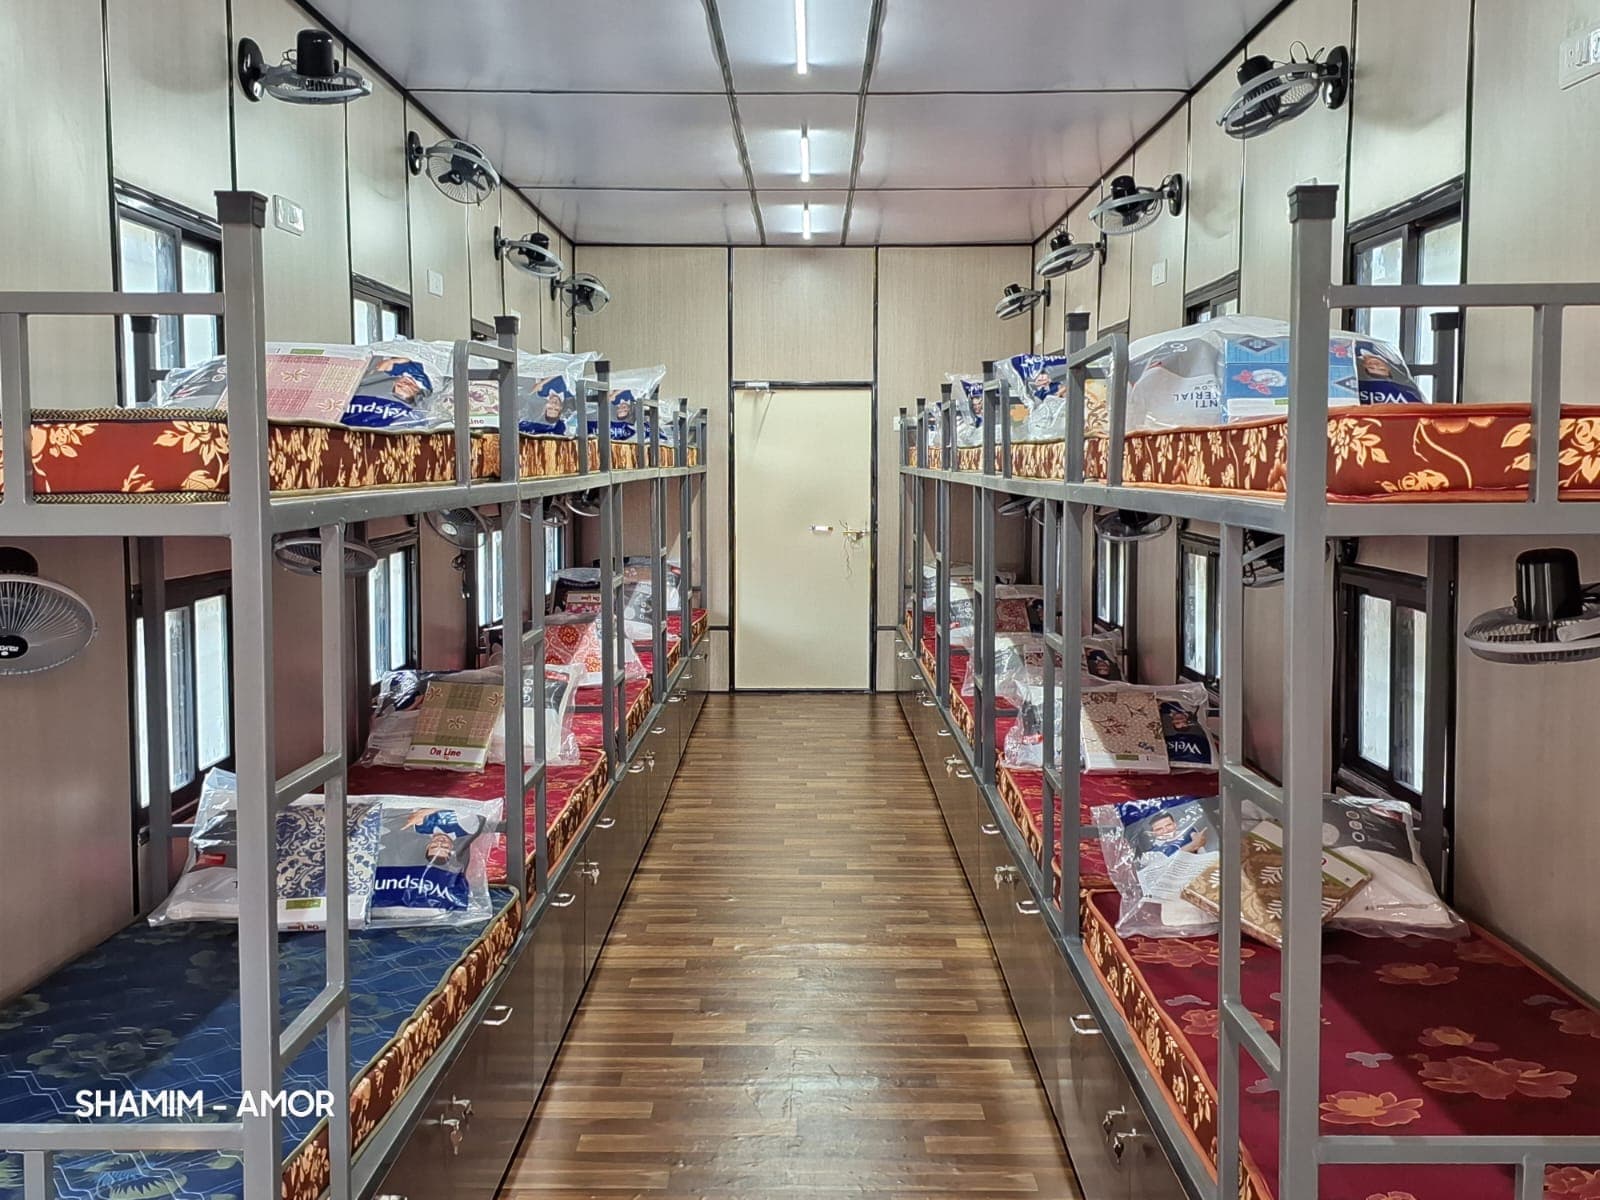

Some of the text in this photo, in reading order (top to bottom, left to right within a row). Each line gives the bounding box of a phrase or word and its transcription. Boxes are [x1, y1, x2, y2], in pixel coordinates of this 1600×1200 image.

[430, 747, 461, 757] On Line
[374, 874, 454, 903] Welspun
